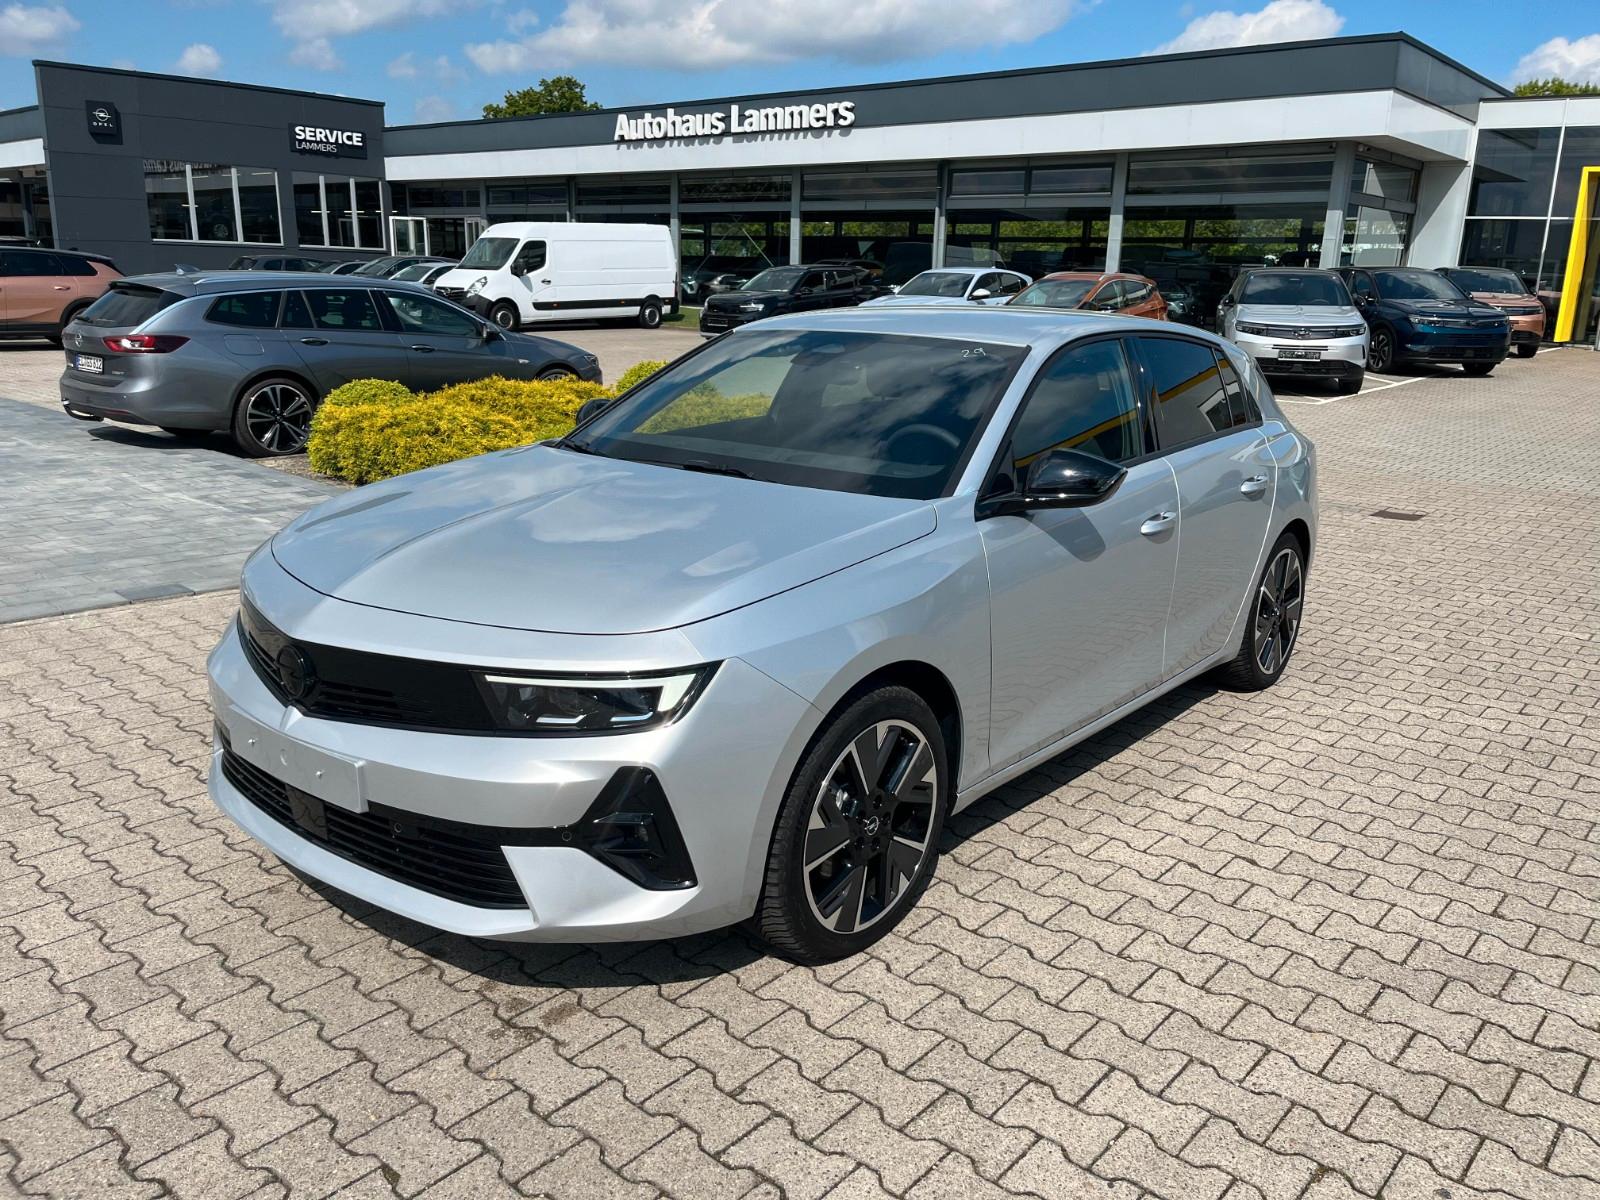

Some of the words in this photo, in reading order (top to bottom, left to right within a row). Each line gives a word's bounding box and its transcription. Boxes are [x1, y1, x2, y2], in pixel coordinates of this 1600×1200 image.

[613, 108, 725, 141] Autohaus
[730, 101, 855, 133] Lammers
[294, 126, 363, 147] SERVICE
[295, 140, 337, 153] LAMMERS
